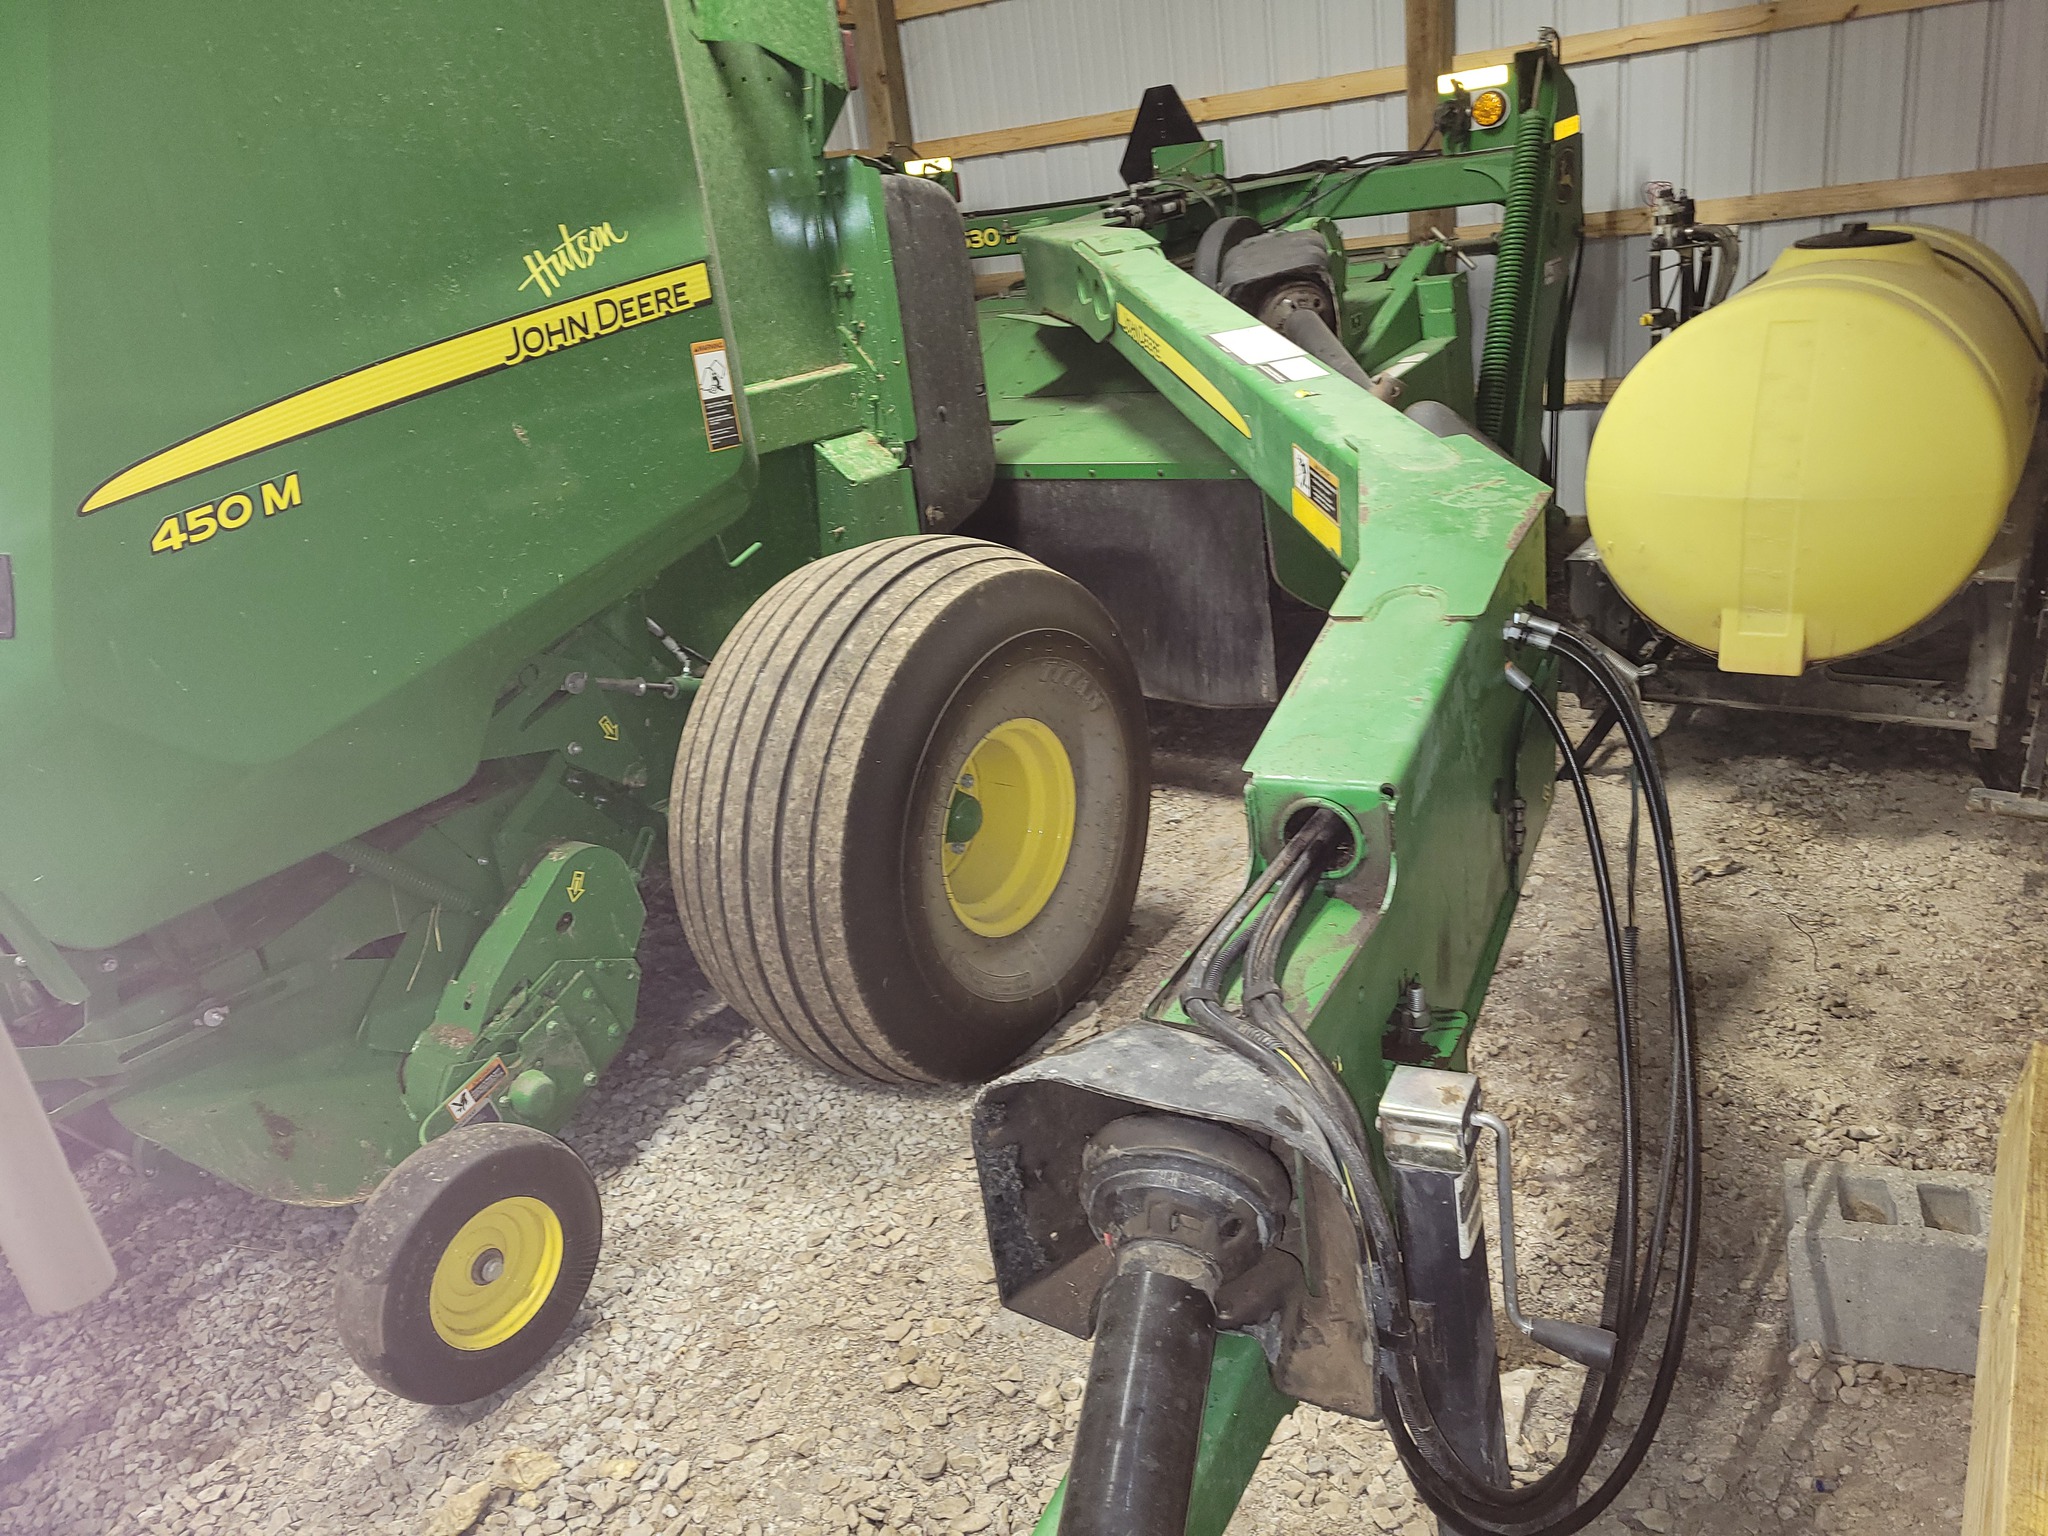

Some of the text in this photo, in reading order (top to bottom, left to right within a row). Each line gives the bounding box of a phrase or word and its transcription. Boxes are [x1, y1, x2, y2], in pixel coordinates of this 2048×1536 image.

[518, 222, 628, 297] Hutson
[963, 227, 1000, 249] 30
[505, 282, 690, 361] JOHN DEERE
[151, 473, 302, 554] 450 M
